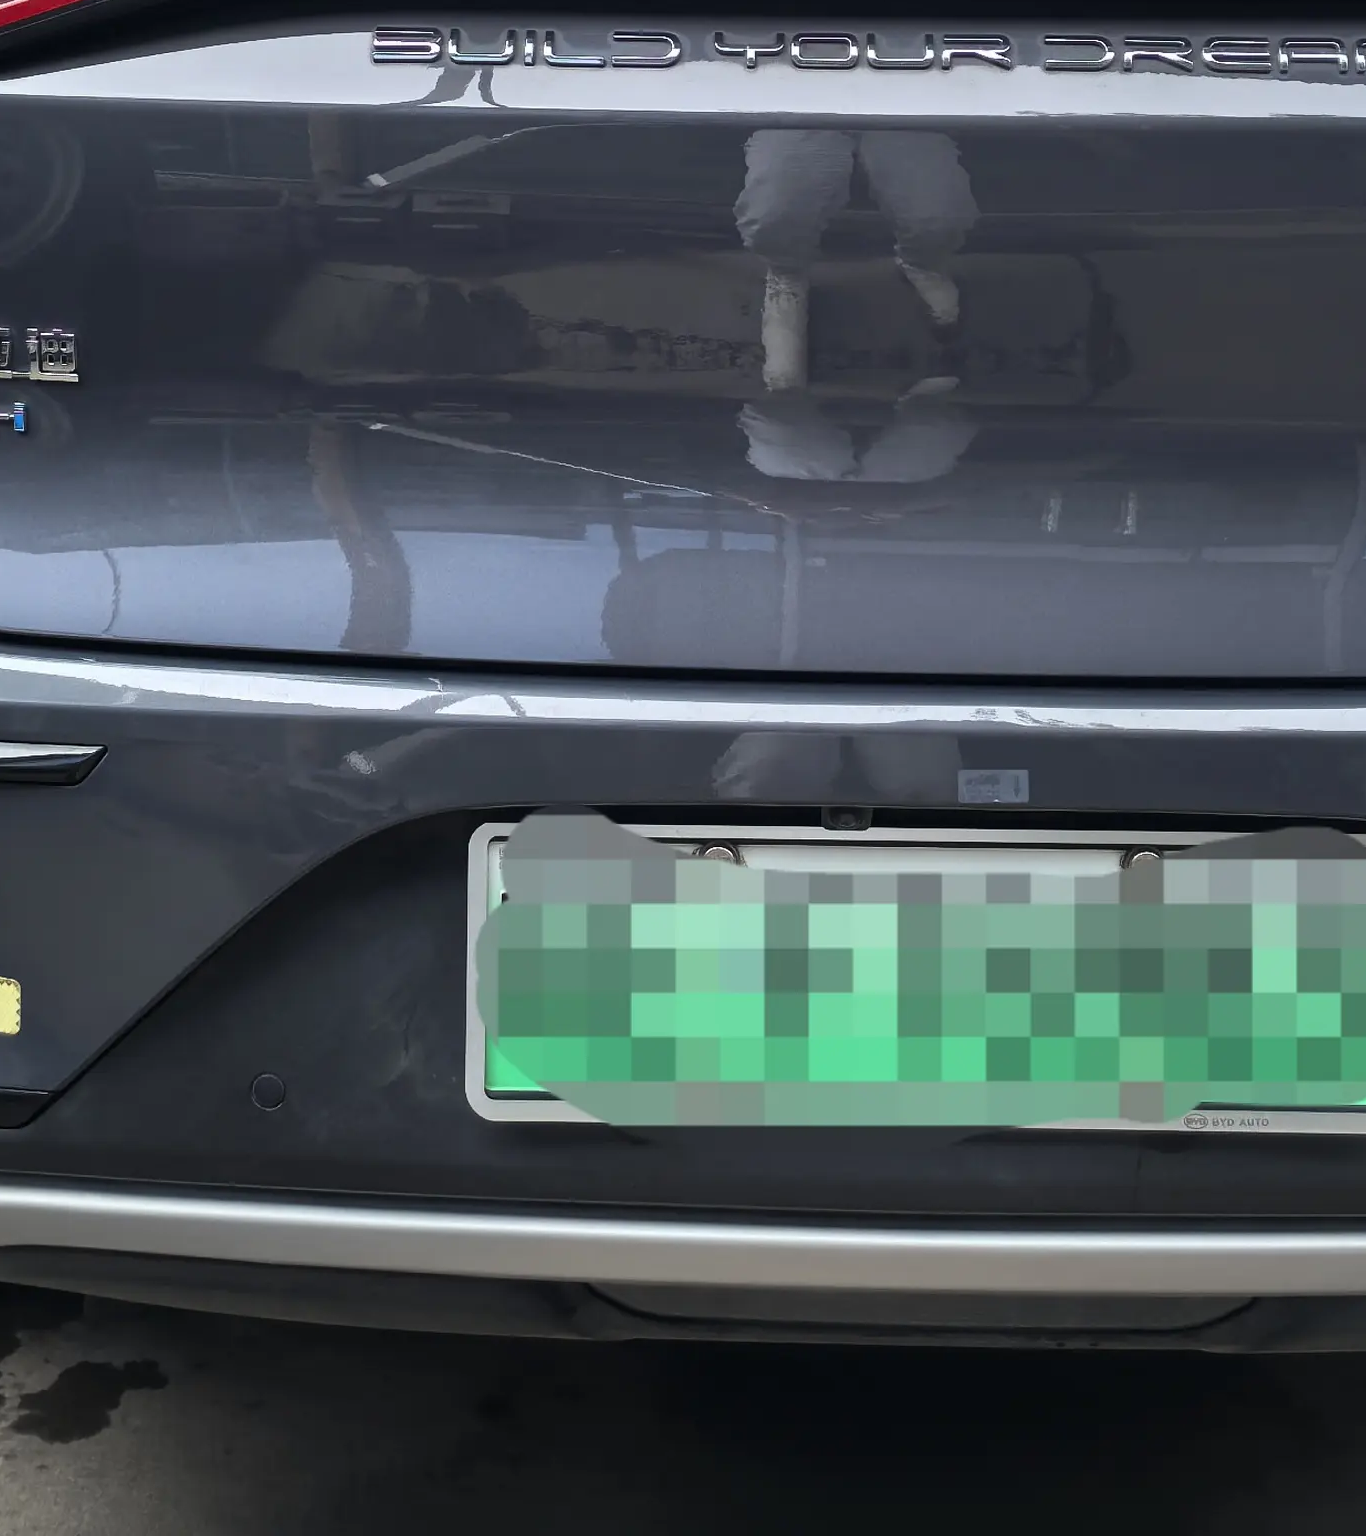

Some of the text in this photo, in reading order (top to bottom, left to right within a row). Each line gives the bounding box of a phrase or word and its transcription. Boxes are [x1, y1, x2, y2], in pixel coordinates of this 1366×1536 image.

[372, 26, 681, 67] BUILD
[713, 30, 1013, 71] YOUR
[1239, 1117, 1270, 1128] AUTO
